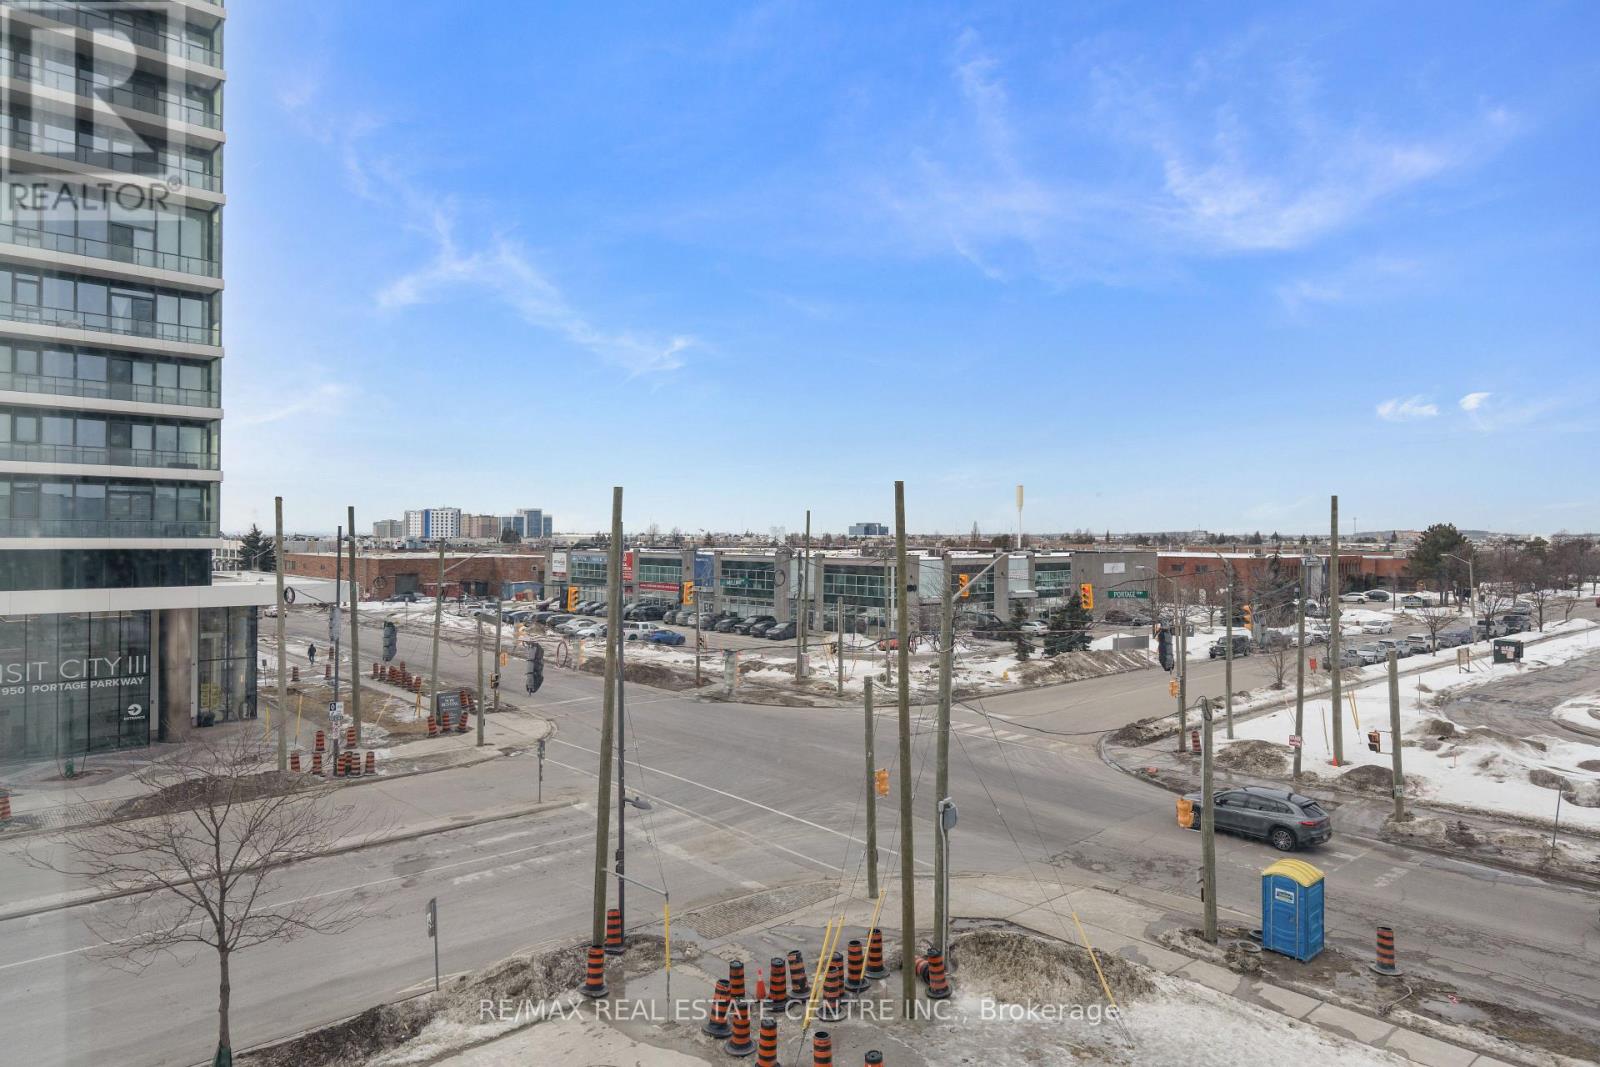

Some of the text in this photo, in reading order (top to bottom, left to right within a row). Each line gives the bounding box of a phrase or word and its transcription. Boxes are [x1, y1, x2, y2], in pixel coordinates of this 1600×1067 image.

[60, 656, 122, 679] CITY
[128, 655, 147, 675] III
[1, 677, 145, 696] 950 PORTAGE PARKWAY
